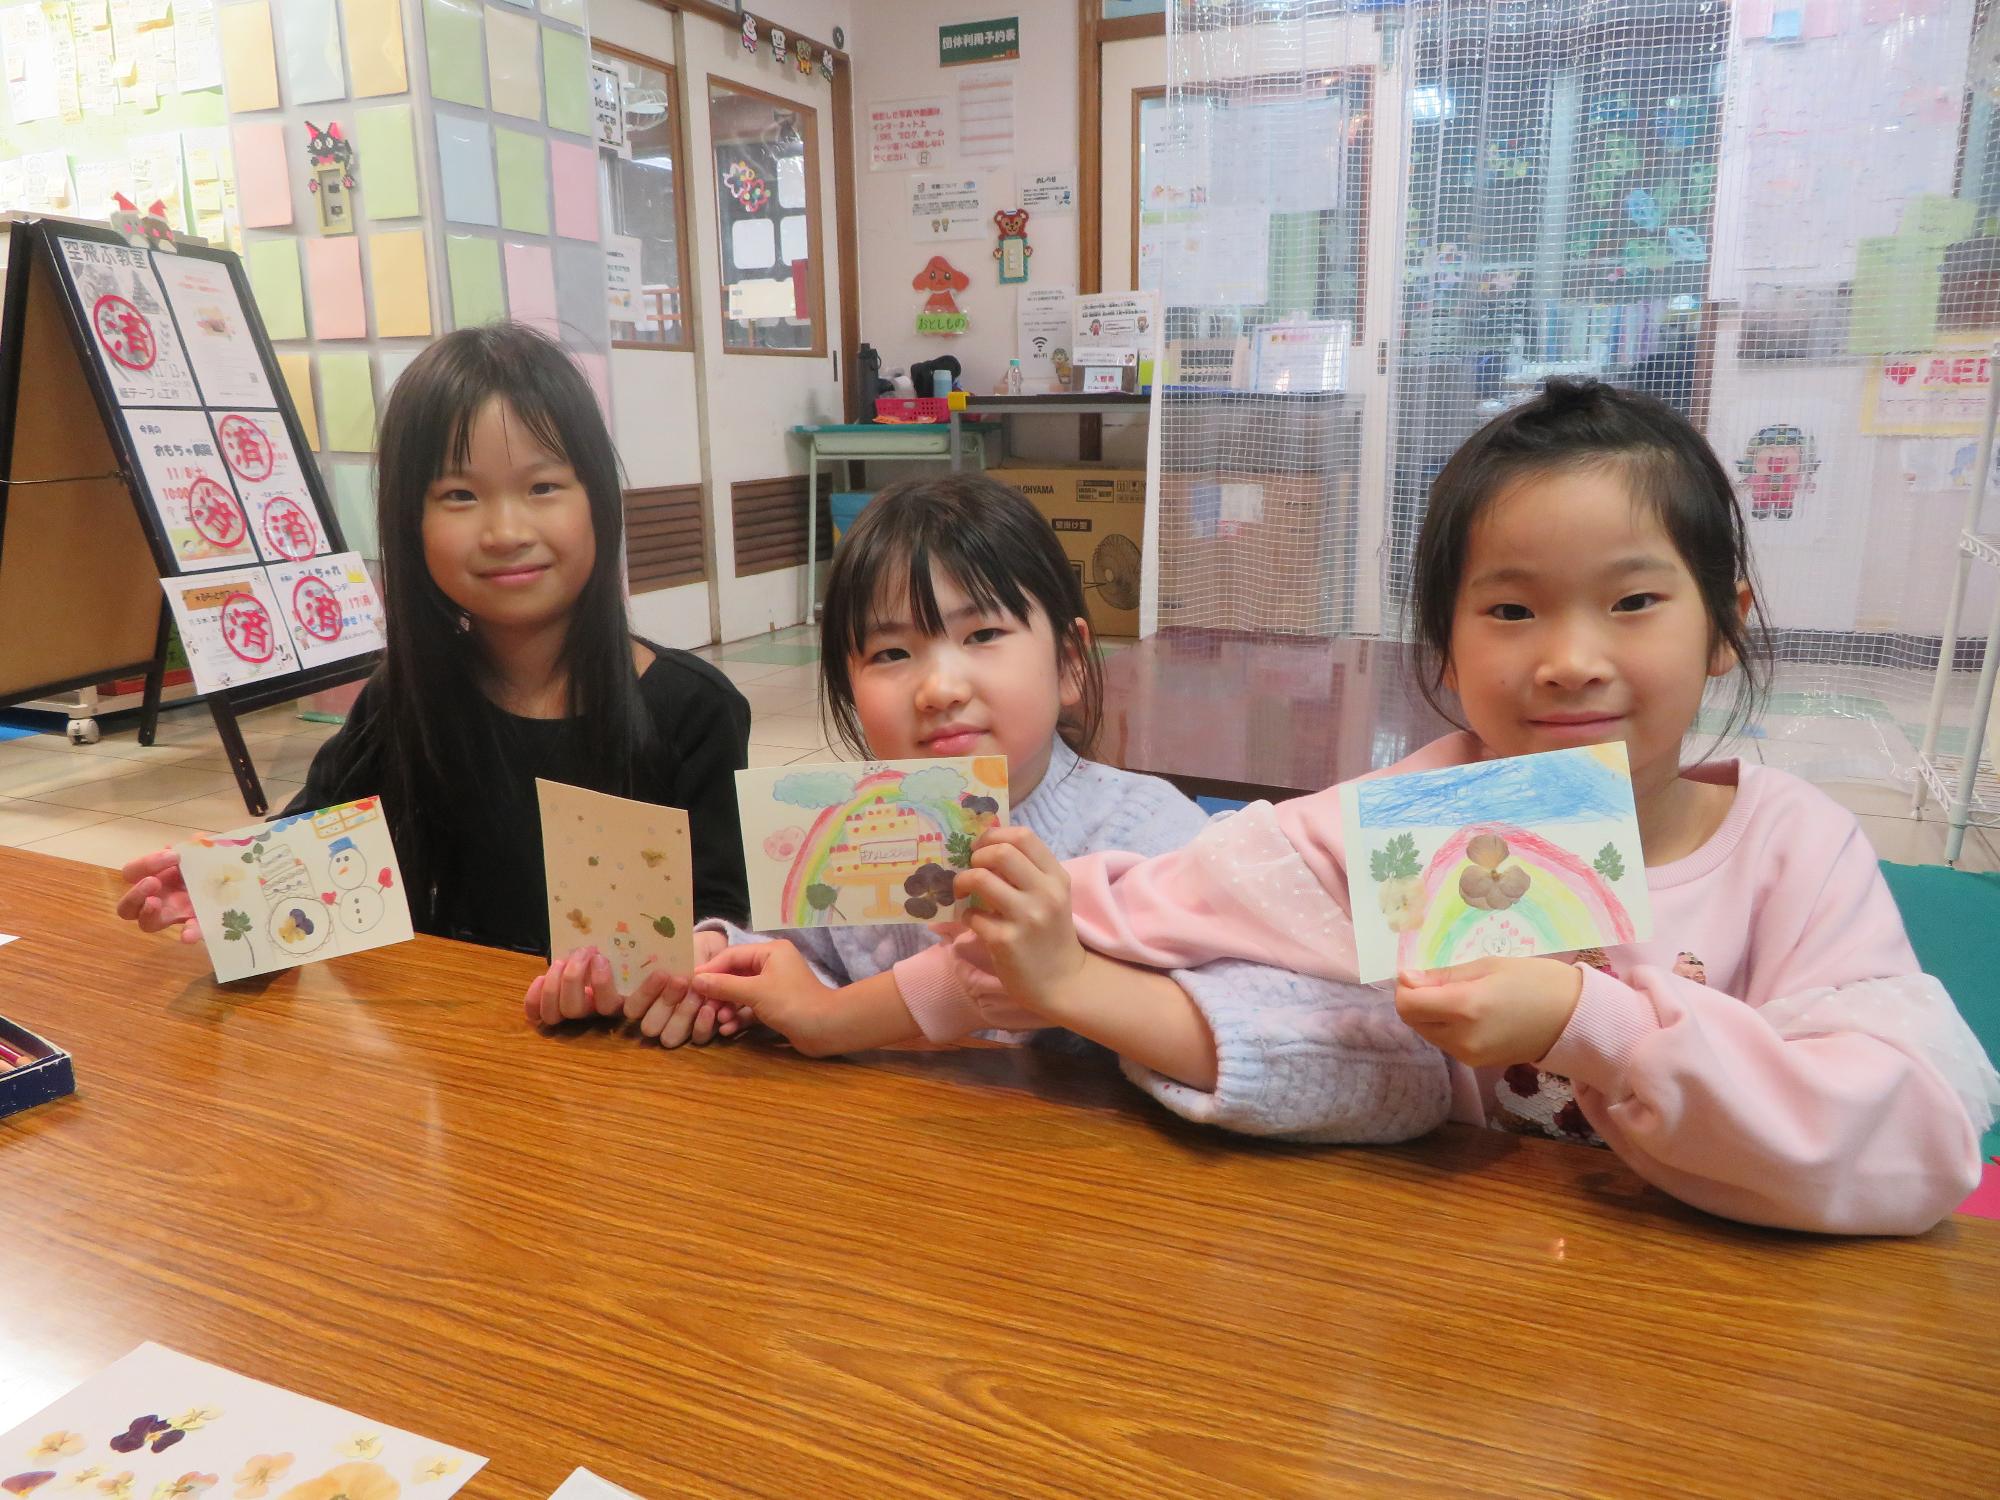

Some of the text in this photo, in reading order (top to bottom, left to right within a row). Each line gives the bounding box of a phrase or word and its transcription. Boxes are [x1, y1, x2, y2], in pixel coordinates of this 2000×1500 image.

[942, 28, 1016, 50] 団体利用予約表
[917, 317, 966, 331] おとしもの
[1023, 485, 1055, 494] OHYAMA
